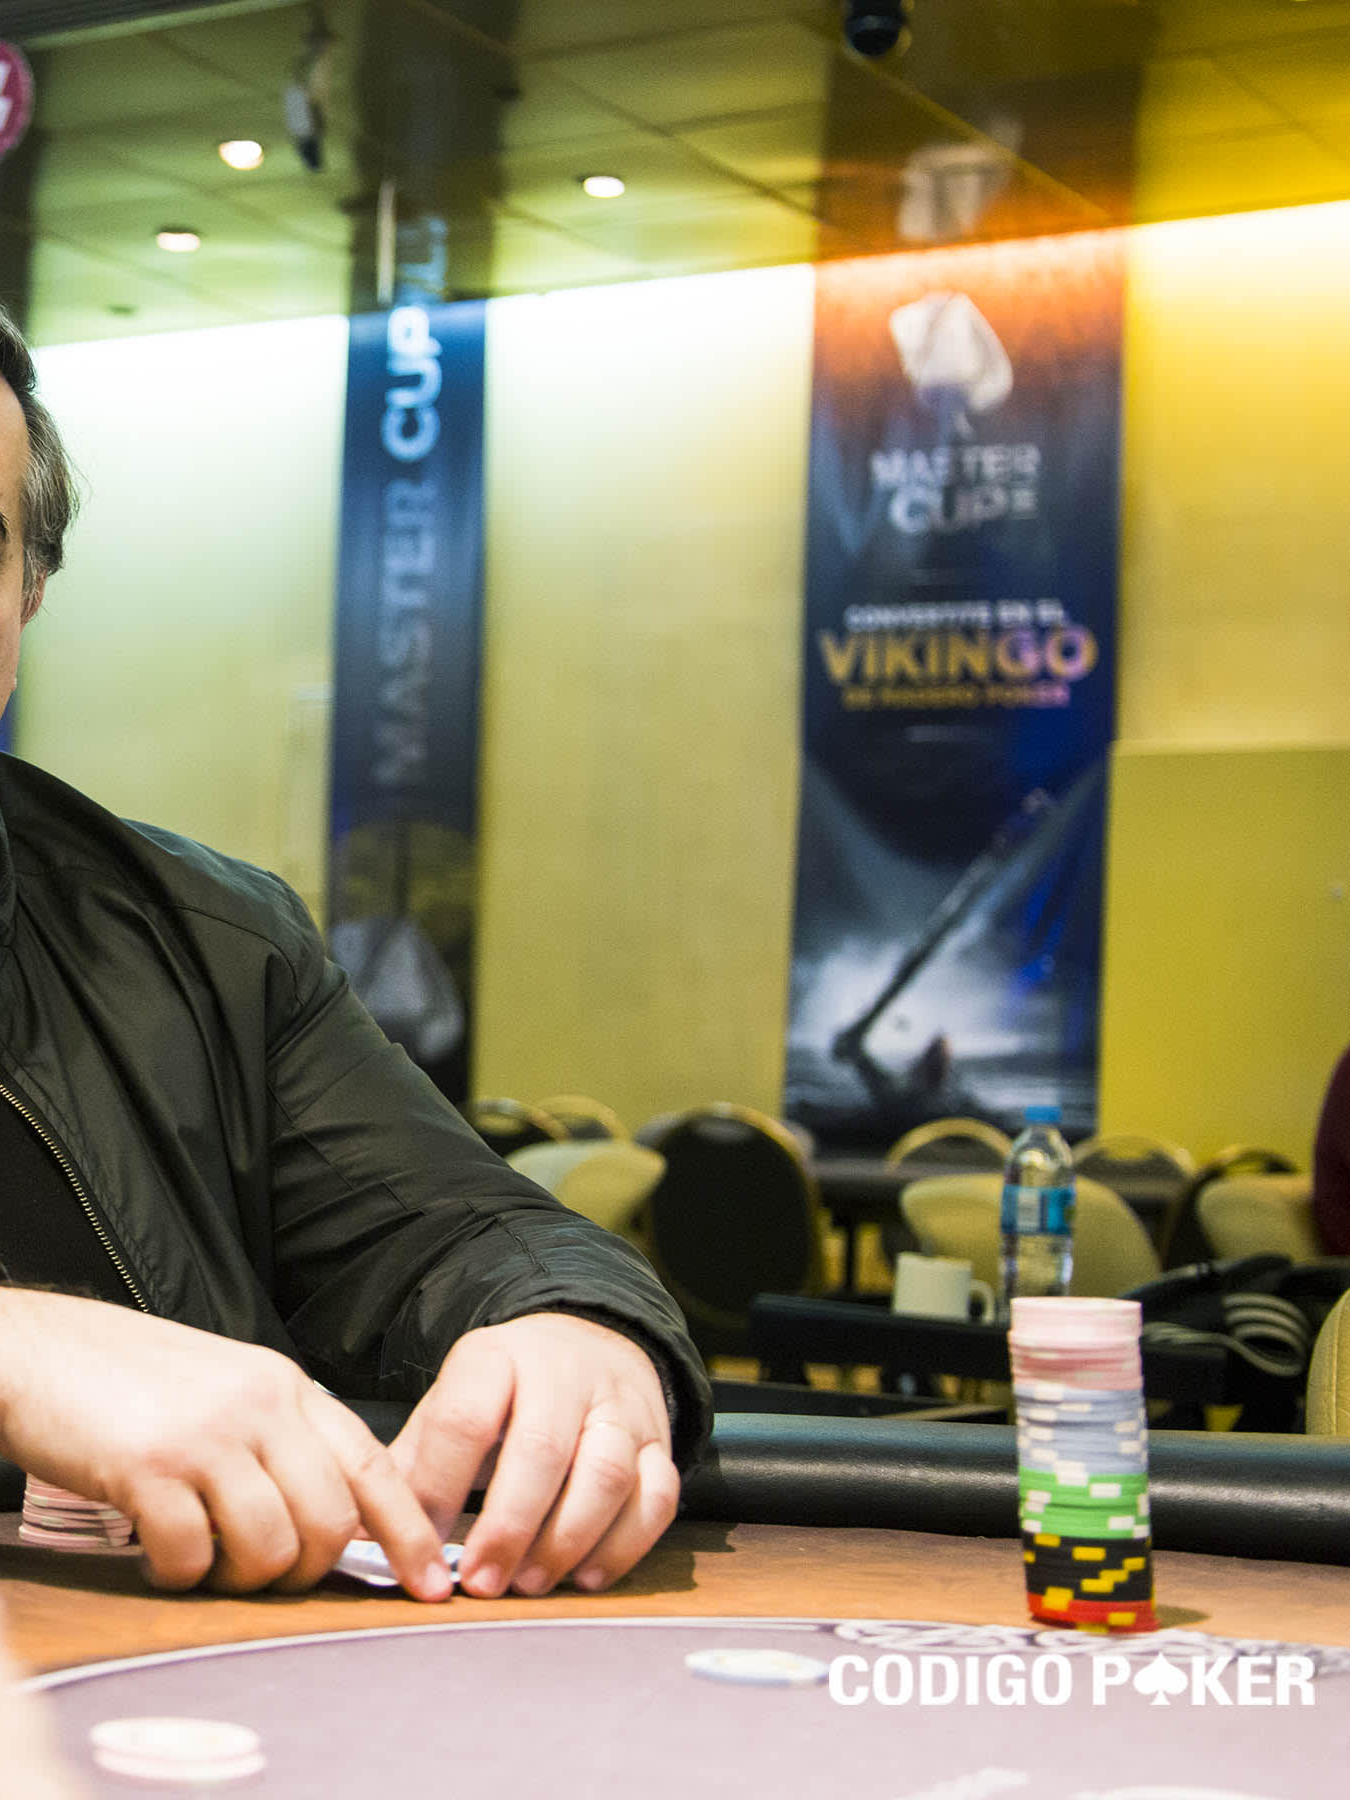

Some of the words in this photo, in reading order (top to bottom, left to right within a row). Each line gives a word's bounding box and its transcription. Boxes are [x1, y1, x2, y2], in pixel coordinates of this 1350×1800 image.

[381, 306, 442, 462] CUP
[889, 486, 1007, 533] CUP
[817, 625, 1098, 684] VIKINGO
